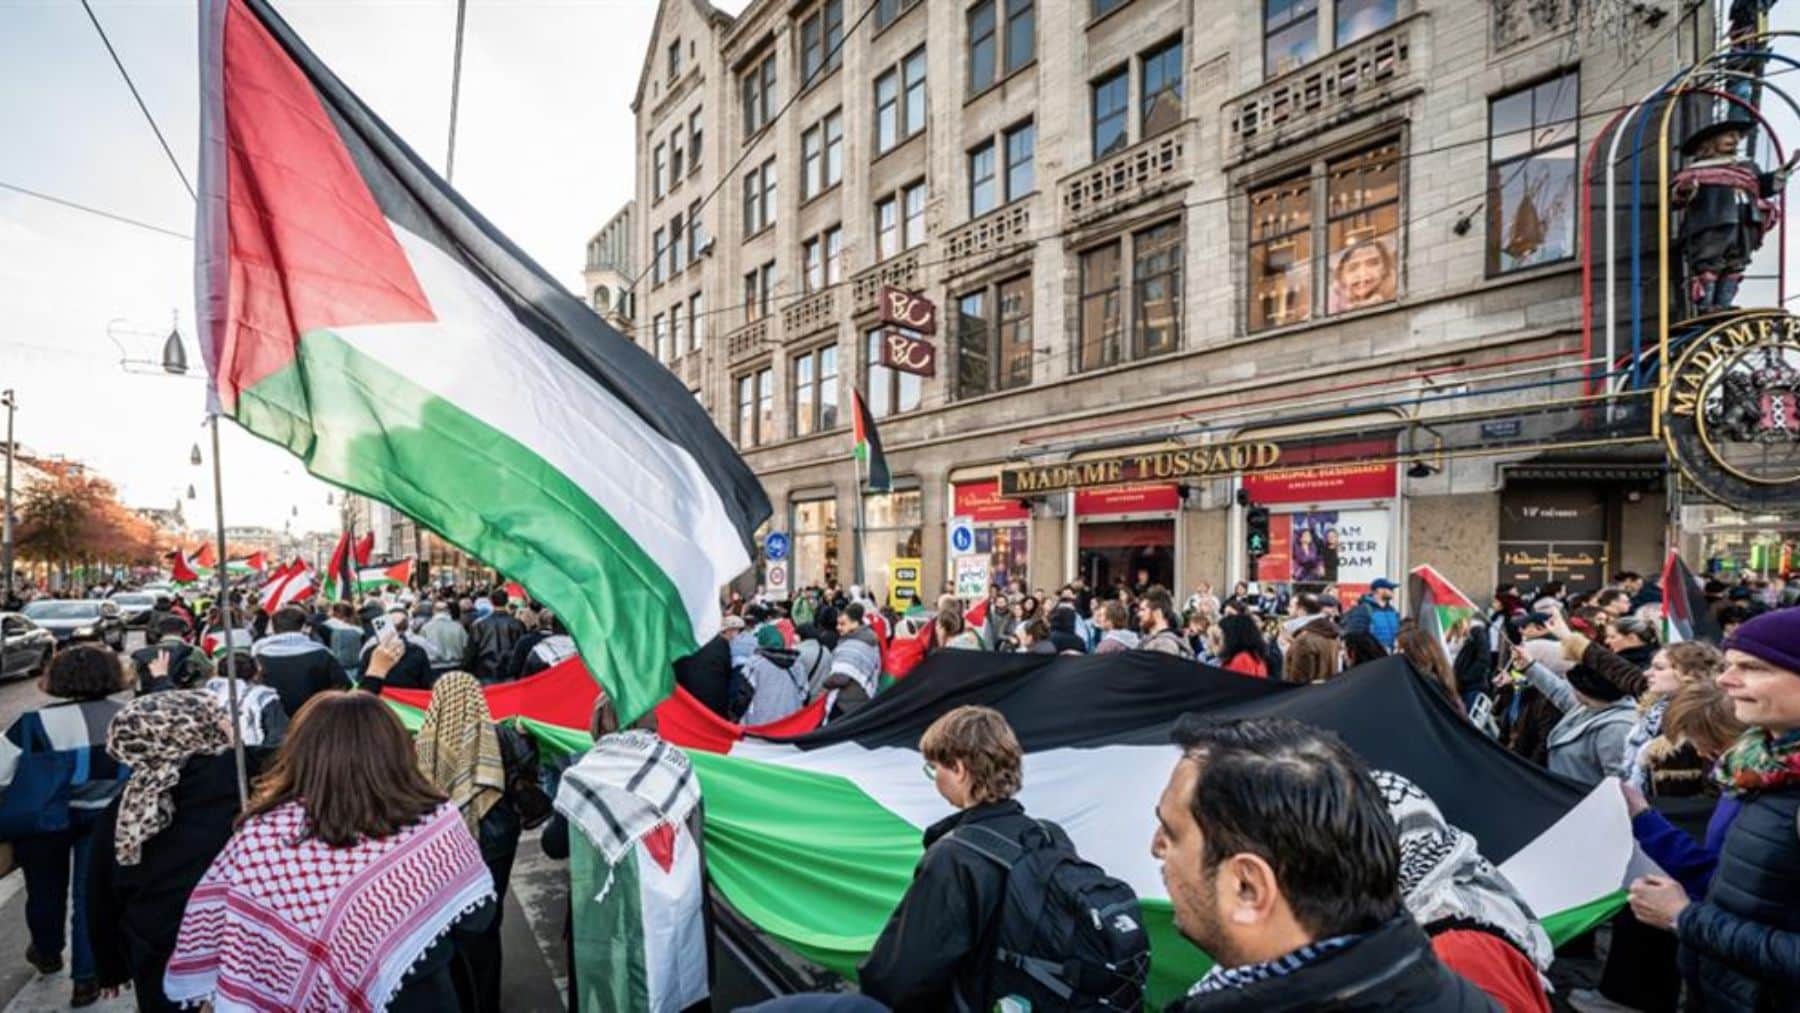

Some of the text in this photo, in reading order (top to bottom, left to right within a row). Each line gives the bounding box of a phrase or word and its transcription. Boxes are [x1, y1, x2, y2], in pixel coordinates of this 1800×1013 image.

[1672, 319, 1774, 416] MADAME
[1016, 460, 1122, 491] MADAME
[1134, 442, 1281, 479] TUSSAUD
[1339, 526, 1362, 537] AM
[1338, 540, 1377, 553] STER
[1337, 556, 1373, 568] DAM
